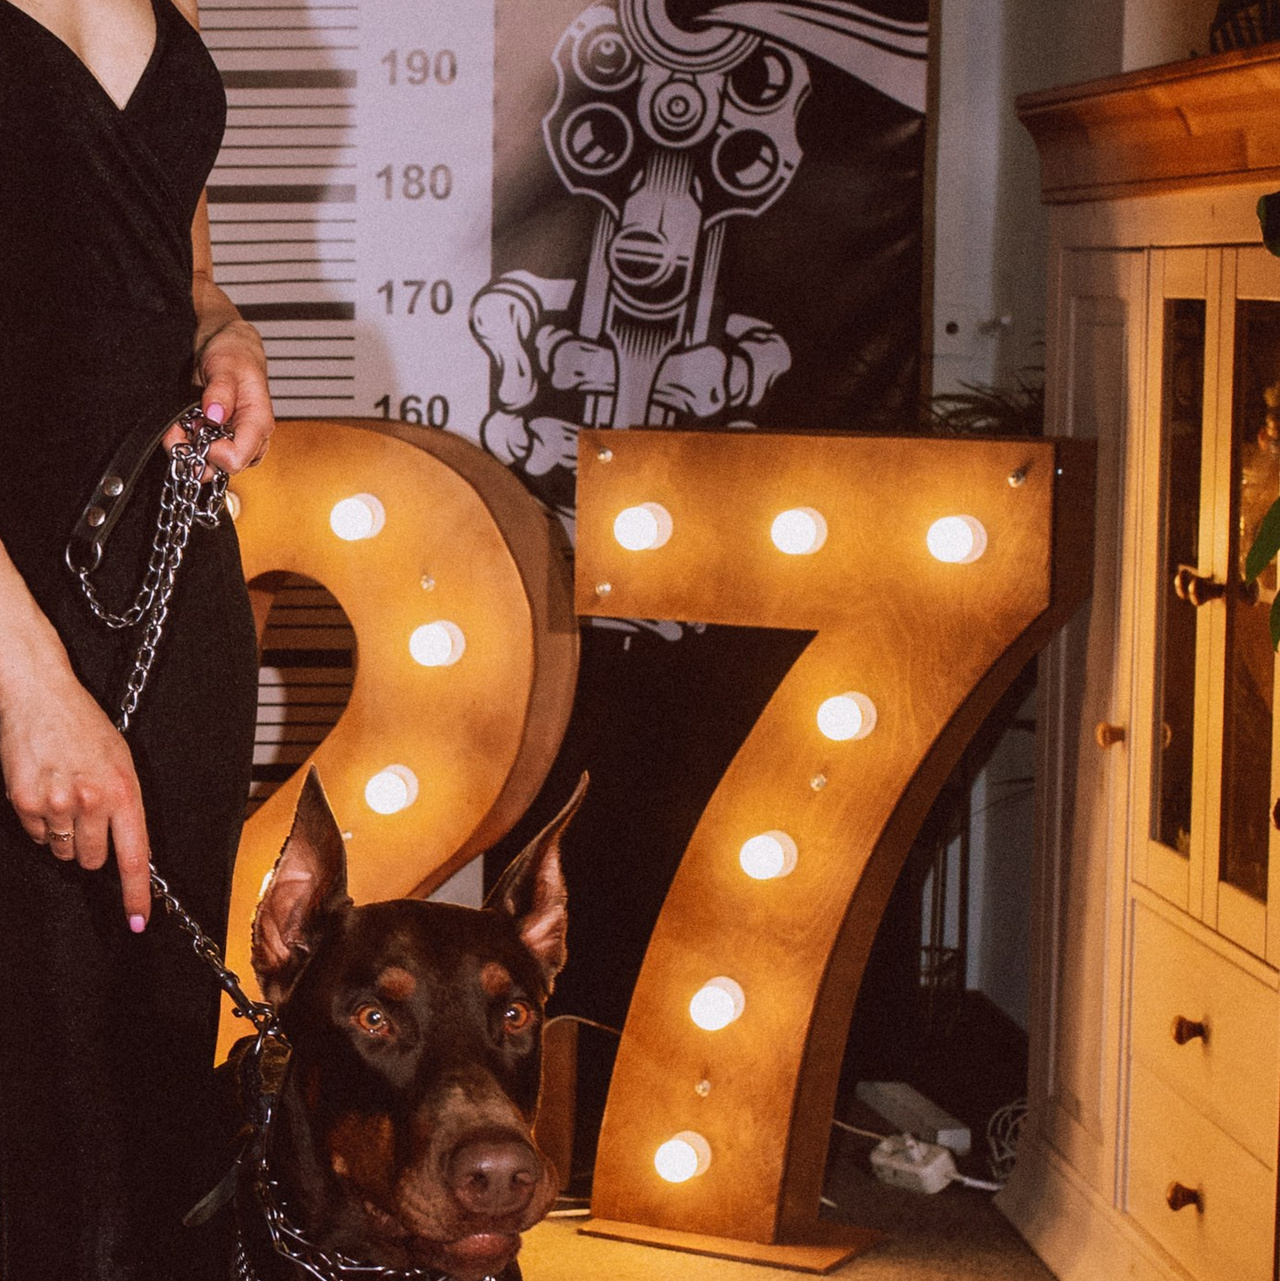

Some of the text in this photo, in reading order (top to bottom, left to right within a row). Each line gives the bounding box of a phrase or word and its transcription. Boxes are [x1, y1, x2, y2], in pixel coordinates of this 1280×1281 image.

[383, 48, 458, 85] 190
[375, 163, 453, 200] 180
[377, 280, 454, 316] 170
[373, 393, 450, 431] 160
